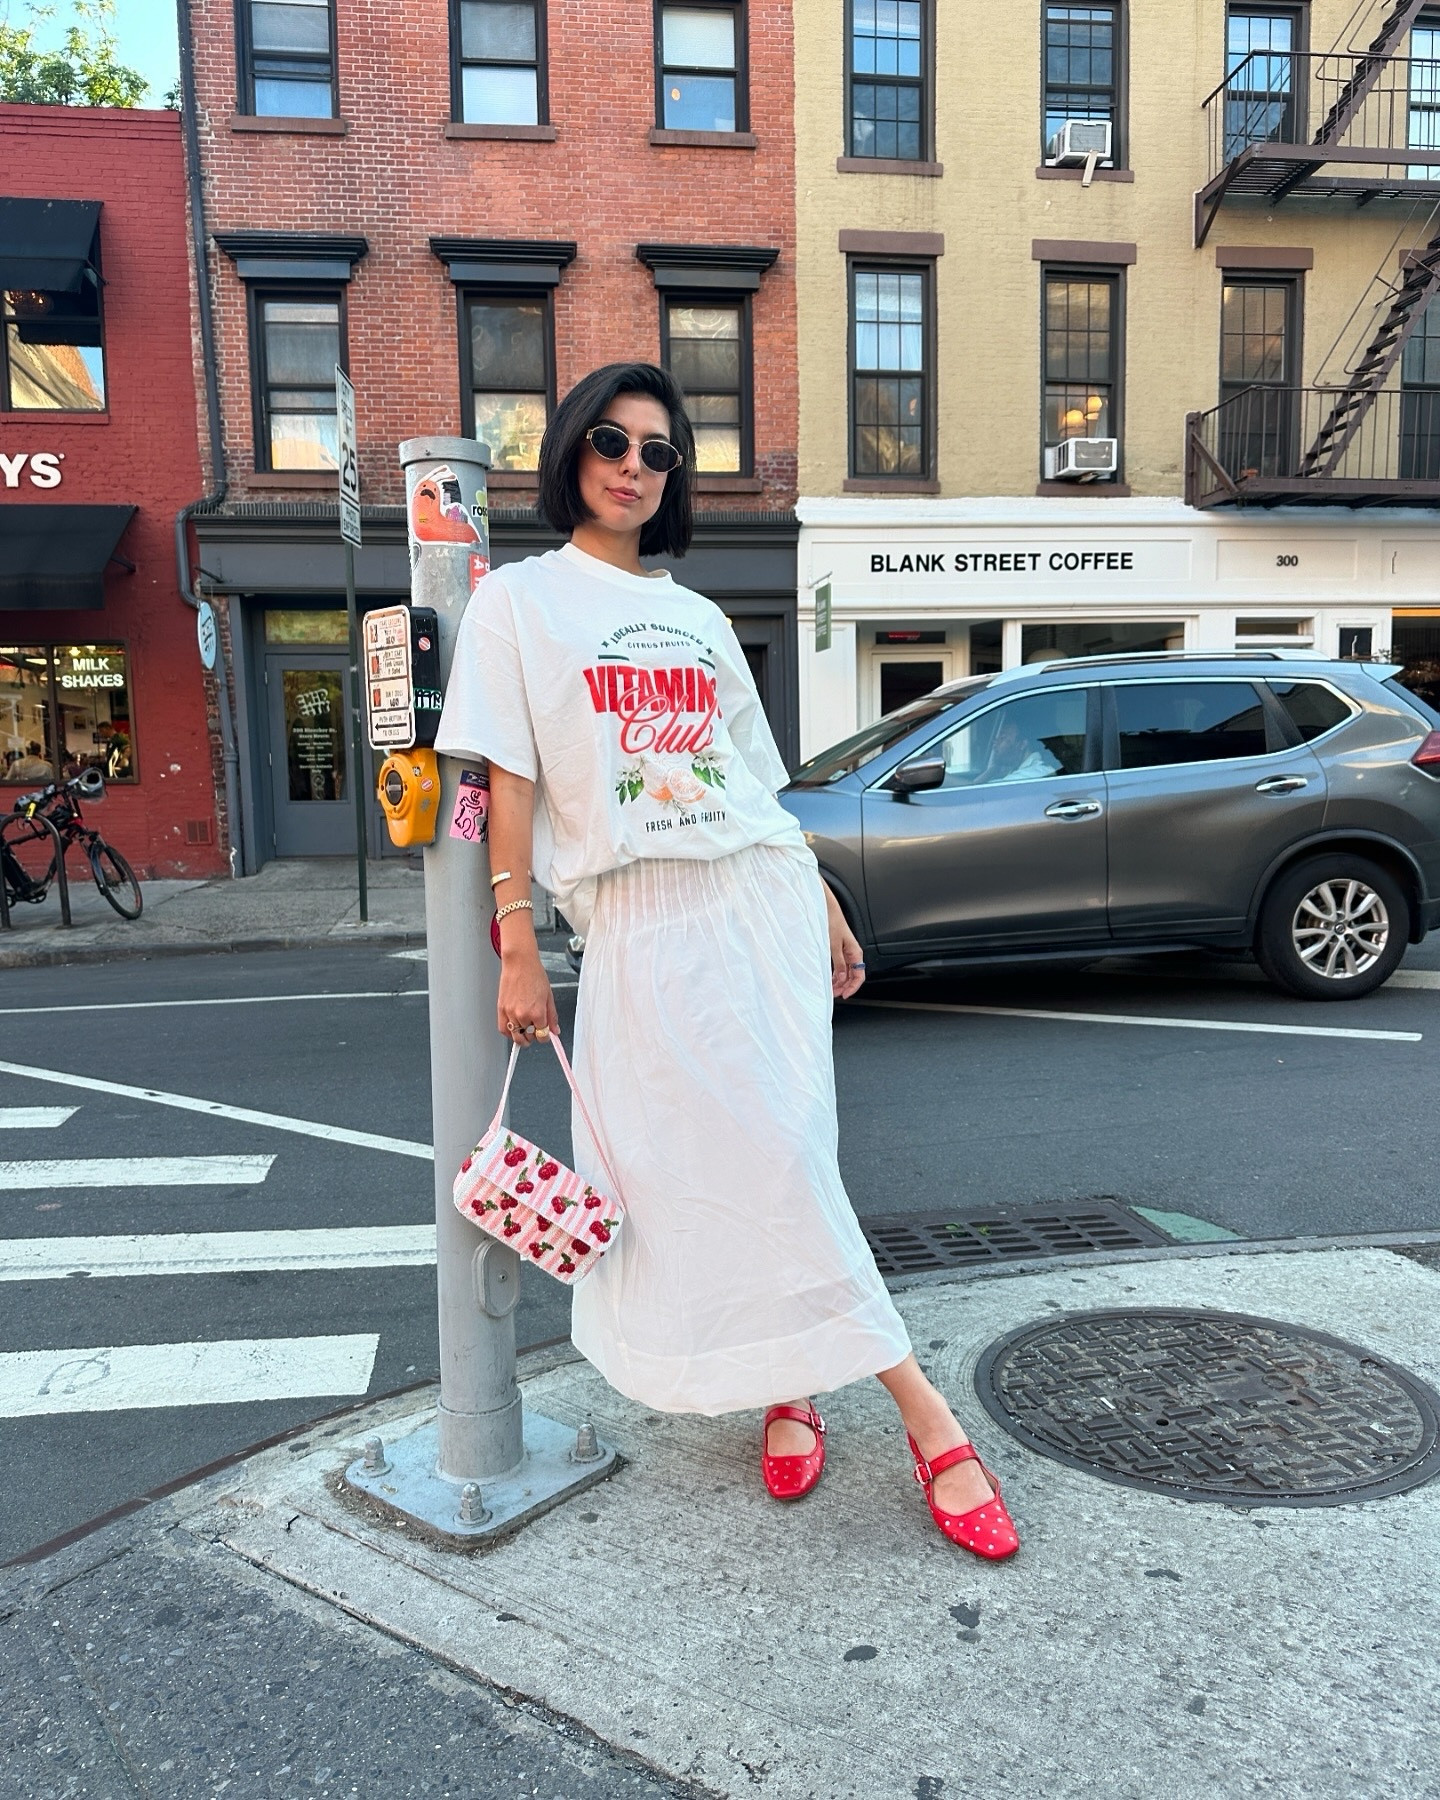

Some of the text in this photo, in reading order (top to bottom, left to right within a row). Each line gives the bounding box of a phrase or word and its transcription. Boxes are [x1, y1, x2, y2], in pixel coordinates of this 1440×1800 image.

[342, 441, 356, 493] 25
[871, 552, 1133, 572] BLANK STREET COFFEE
[1276, 555, 1298, 567] 300
[610, 623, 648, 644] LOCALLY
[628, 641, 658, 649] CITRUS
[72, 657, 110, 671] MILK
[61, 673, 124, 688] SHAKES
[617, 687, 718, 754] Club
[646, 819, 673, 832] FRESH
[679, 814, 697, 827] AND
